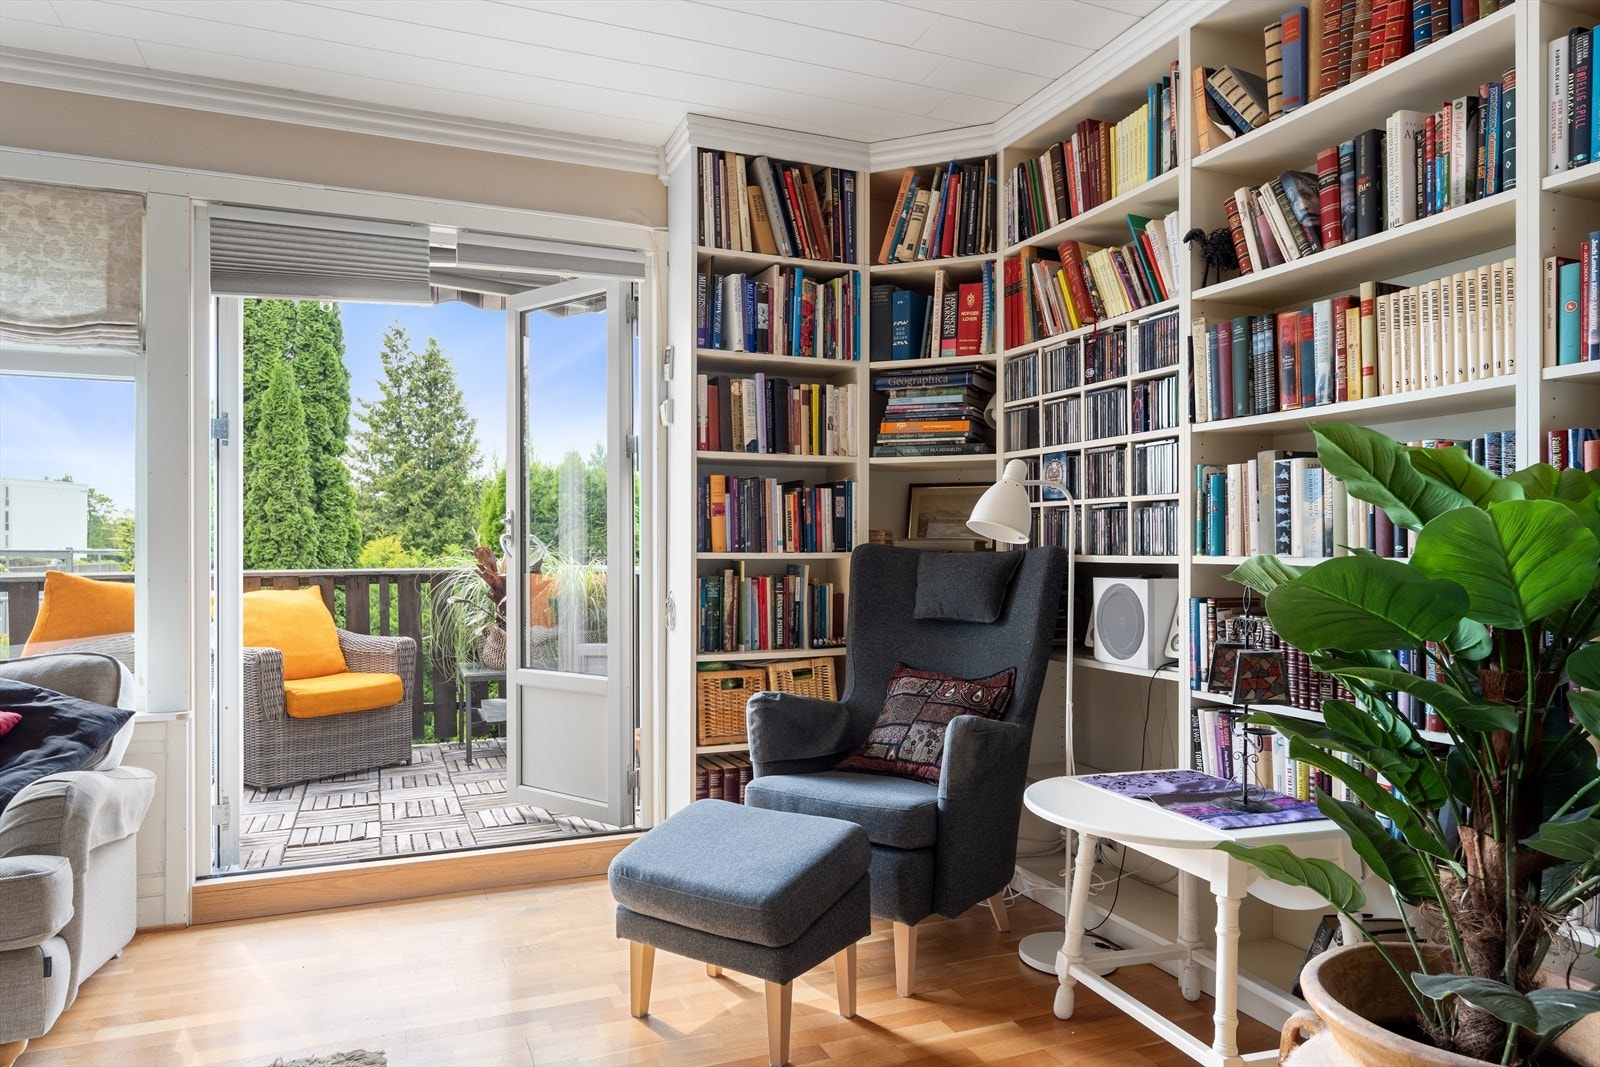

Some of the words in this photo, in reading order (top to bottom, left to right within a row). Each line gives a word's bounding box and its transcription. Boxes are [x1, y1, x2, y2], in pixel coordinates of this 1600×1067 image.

[1575, 36, 1584, 65] KELLERMAN
[1581, 34, 1590, 59] JONATHAN
[1575, 65, 1588, 102] DØDELIG
[1574, 104, 1587, 130] SPILL
[1417, 148, 1423, 158] EN
[1417, 184, 1423, 193] ER
[1506, 267, 1514, 284] JACOB
[1591, 255, 1599, 282] London
[1468, 278, 1476, 294] JACOB
[1480, 273, 1488, 290] JACOB
[1494, 270, 1502, 287] JACOB
[1455, 280, 1464, 296] JACOB
[1590, 282, 1598, 301] KONG
[1392, 298, 1400, 314] JACOB
[1421, 291, 1429, 307] JACOB
[943, 297, 951, 335] LEARNER'S
[1378, 302, 1386, 317] JACOB
[1319, 320, 1329, 336] DAN
[1336, 313, 1345, 350] VINCI-KODEN
[1319, 337, 1329, 363] BROWN
[1336, 354, 1345, 367] DAN
[887, 375, 949, 387] Geographica
[1552, 436, 1561, 453] Faith
[1191, 714, 1199, 727] JON
